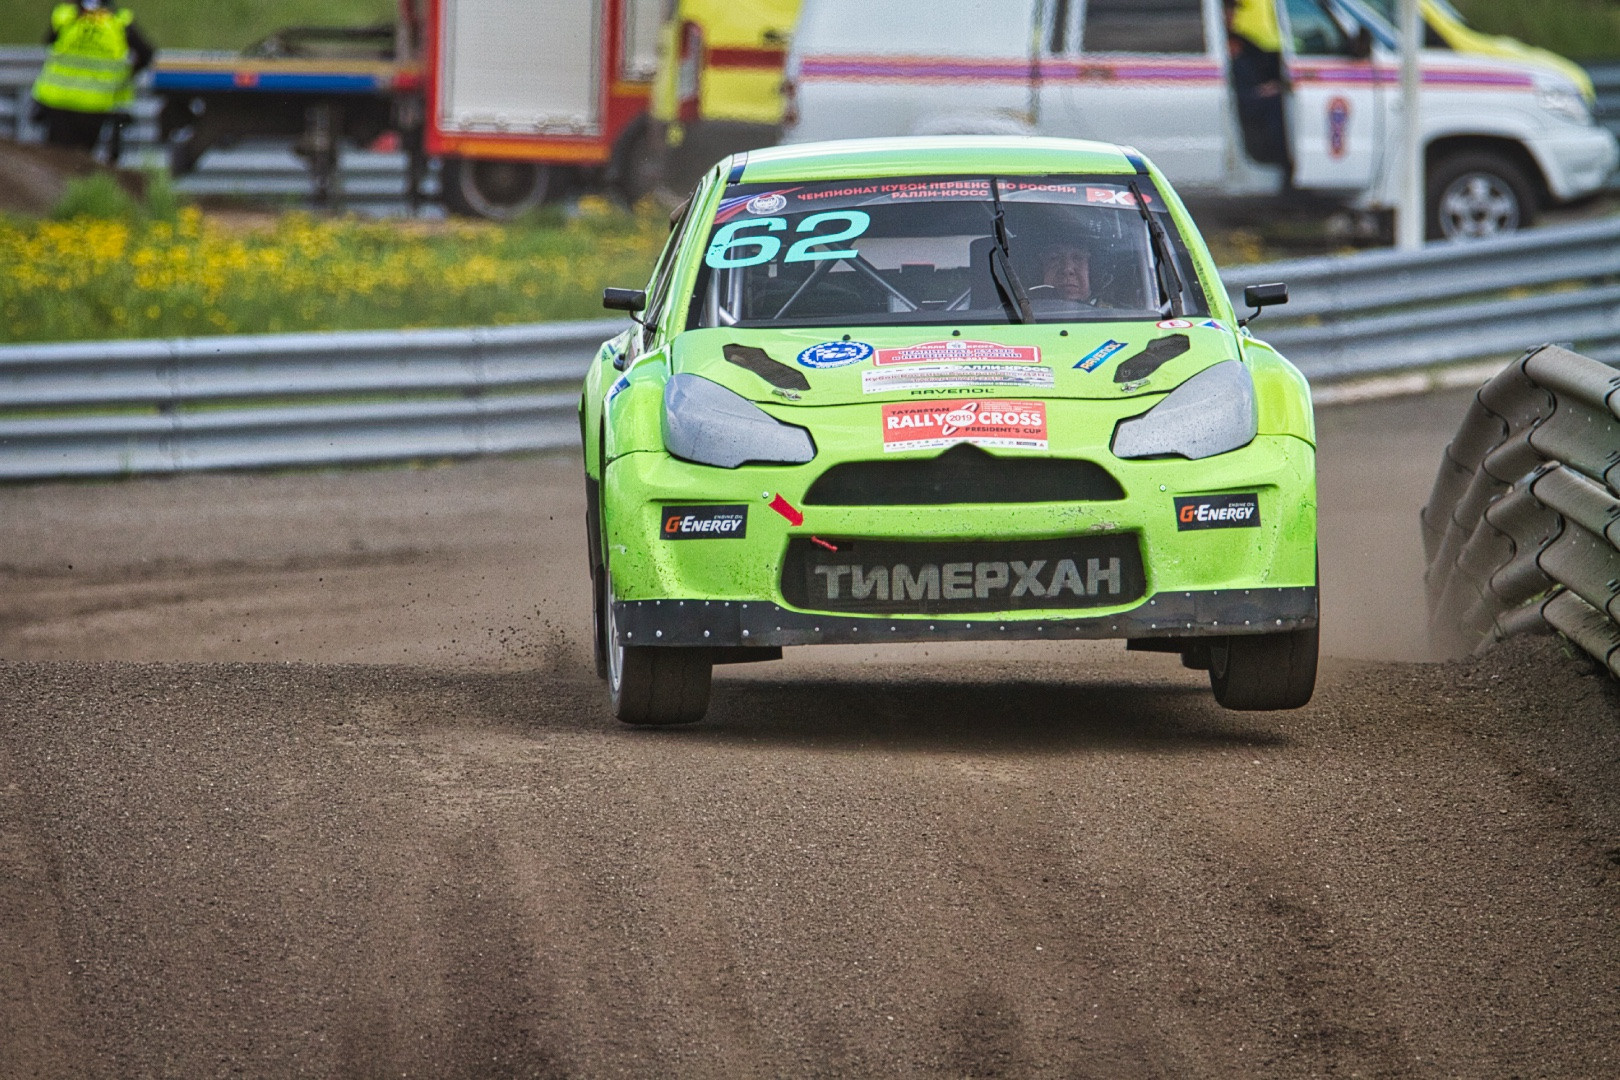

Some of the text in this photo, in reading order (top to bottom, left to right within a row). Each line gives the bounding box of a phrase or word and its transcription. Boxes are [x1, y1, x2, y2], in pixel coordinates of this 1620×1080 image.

[797, 182, 1077, 201] ЧЕМПИОНАТ КУБОК ПЕРВЕНСВО РОССИИ
[891, 189, 989, 199] РАЛЛИ-КРОСС
[705, 210, 871, 269] 62
[955, 365, 1050, 373] РАЛЛИ-КРОСС
[887, 411, 1042, 430] RALLY 2019 CROSS
[891, 407, 950, 415] TATARSTAN
[814, 557, 1121, 601] ТИМЕРХАН
